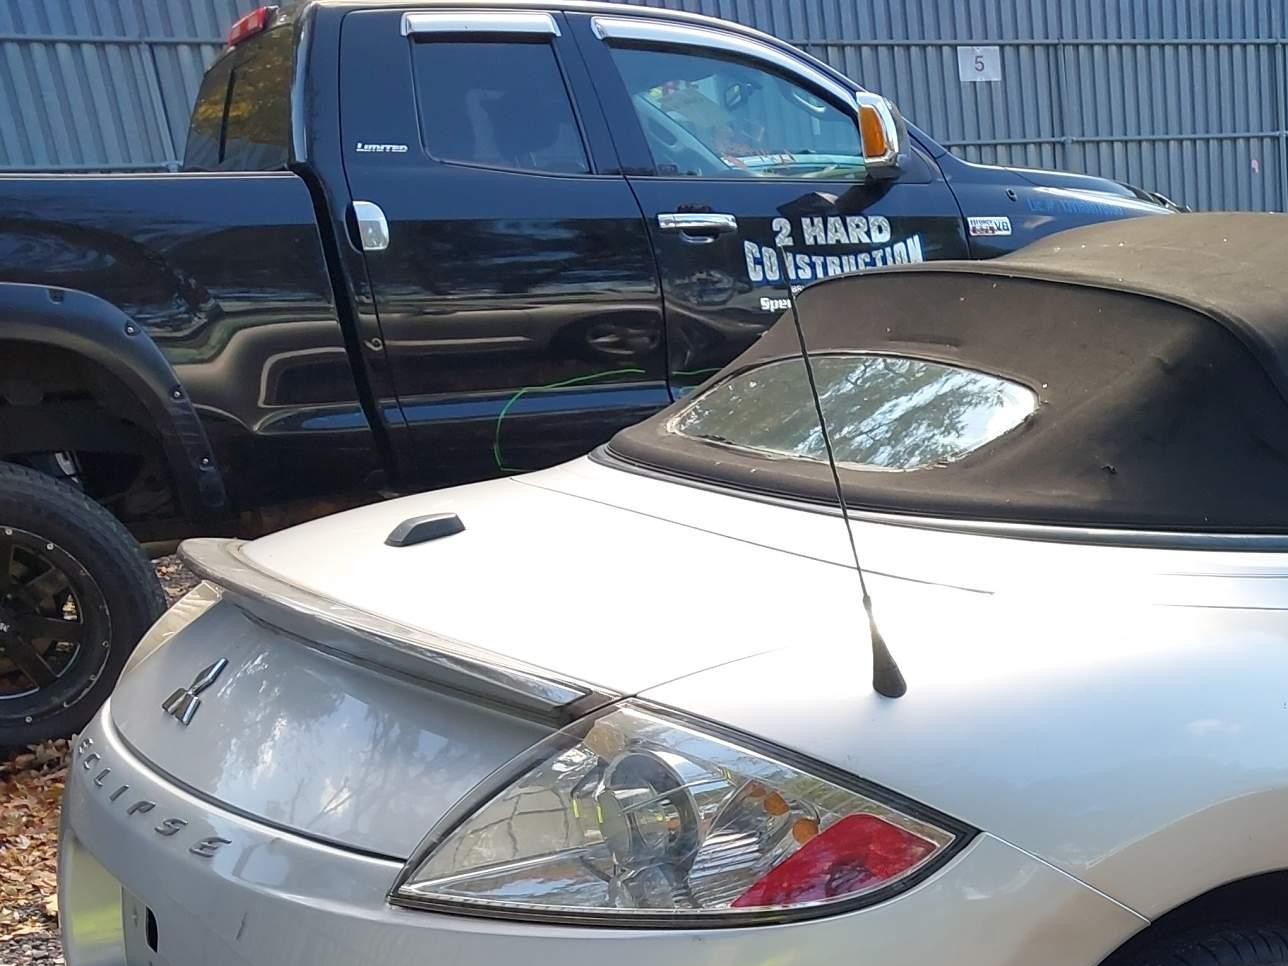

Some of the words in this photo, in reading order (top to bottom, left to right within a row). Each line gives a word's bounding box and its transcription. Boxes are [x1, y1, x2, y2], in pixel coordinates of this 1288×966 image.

[974, 55, 985, 72] 5
[771, 217, 794, 246] 2
[800, 214, 891, 245] HARD
[79, 737, 233, 859] ECLIPSE
